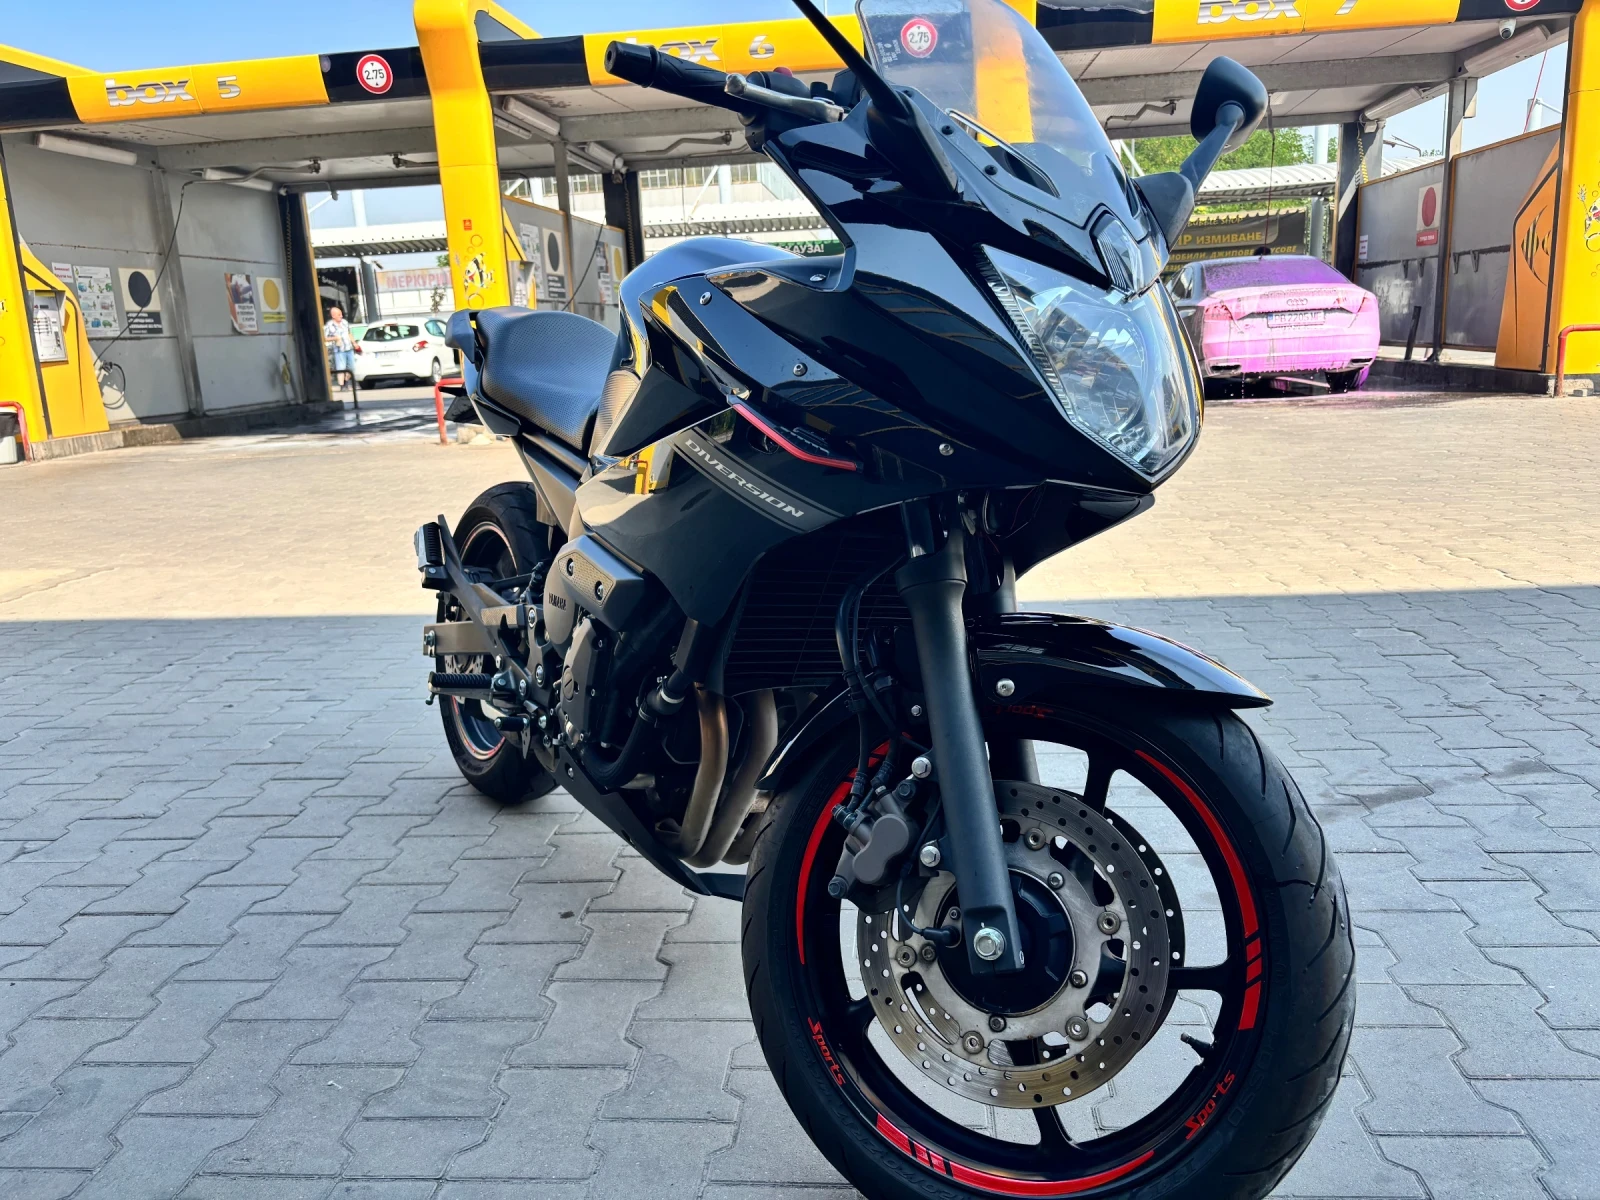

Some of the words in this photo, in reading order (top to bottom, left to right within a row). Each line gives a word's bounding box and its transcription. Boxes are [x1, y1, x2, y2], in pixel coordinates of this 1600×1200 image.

[626, 38, 721, 64] ox
[749, 35, 775, 60] 6
[908, 31, 930, 44] 2.75
[364, 69, 385, 80] 2.75
[104, 78, 195, 107] box
[217, 75, 241, 99] 5
[1196, 231, 1262, 245] ИЗМИВАНЕ
[386, 271, 451, 290] МЕРКУРИ
[685, 438, 804, 518] DIVERSION
[807, 1016, 846, 1086] Sports
